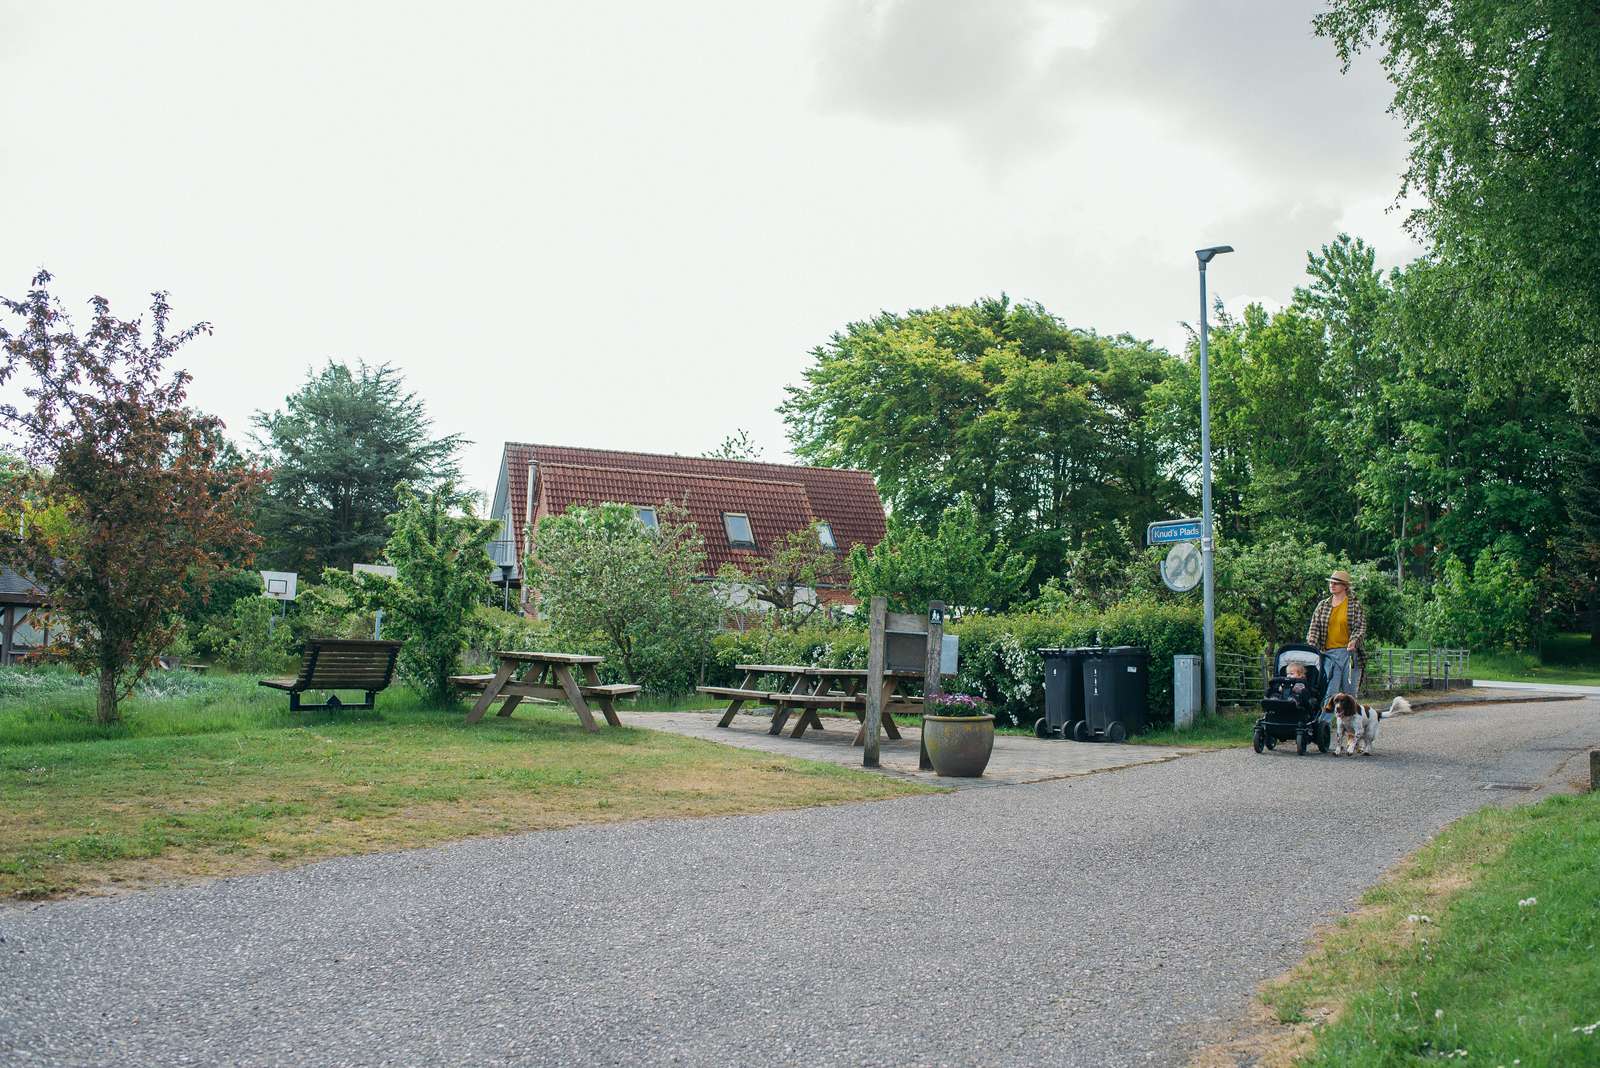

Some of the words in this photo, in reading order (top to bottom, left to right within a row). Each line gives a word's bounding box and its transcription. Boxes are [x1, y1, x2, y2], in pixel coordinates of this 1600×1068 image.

[1154, 529, 1178, 538] Knud's
[1179, 527, 1200, 536] Plads
[1170, 554, 1199, 577] 20
